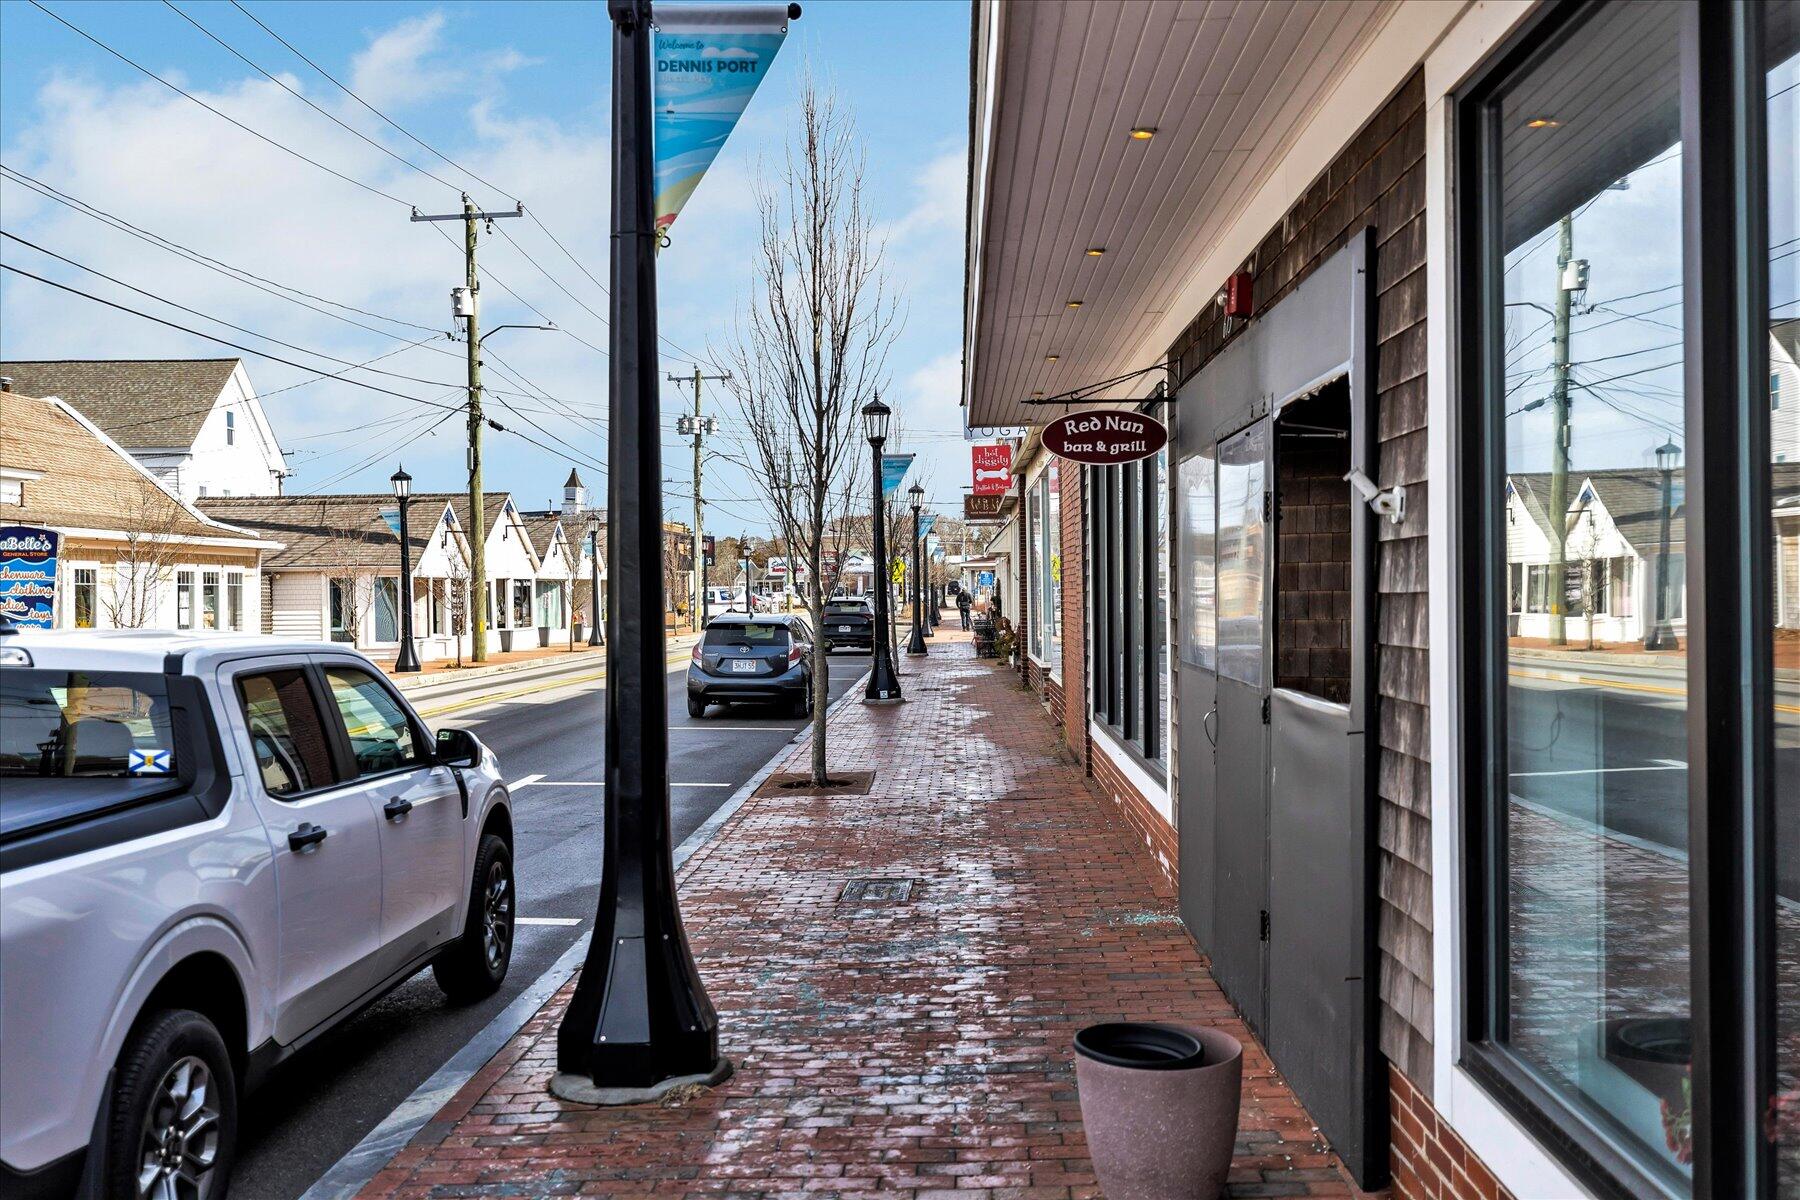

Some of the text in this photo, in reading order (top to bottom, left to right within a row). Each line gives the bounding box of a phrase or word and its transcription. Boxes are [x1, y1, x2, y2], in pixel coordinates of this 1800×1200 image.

[659, 39, 705, 50] Welcome to
[658, 60, 758, 73] DENNIS PORT
[966, 426, 1028, 437] YOGA
[1064, 416, 1144, 435] Red Nun
[984, 447, 999, 457] hot
[1063, 440, 1147, 455] bar & grill
[9, 582, 54, 598] clothing
[28, 608, 52, 622] toys
